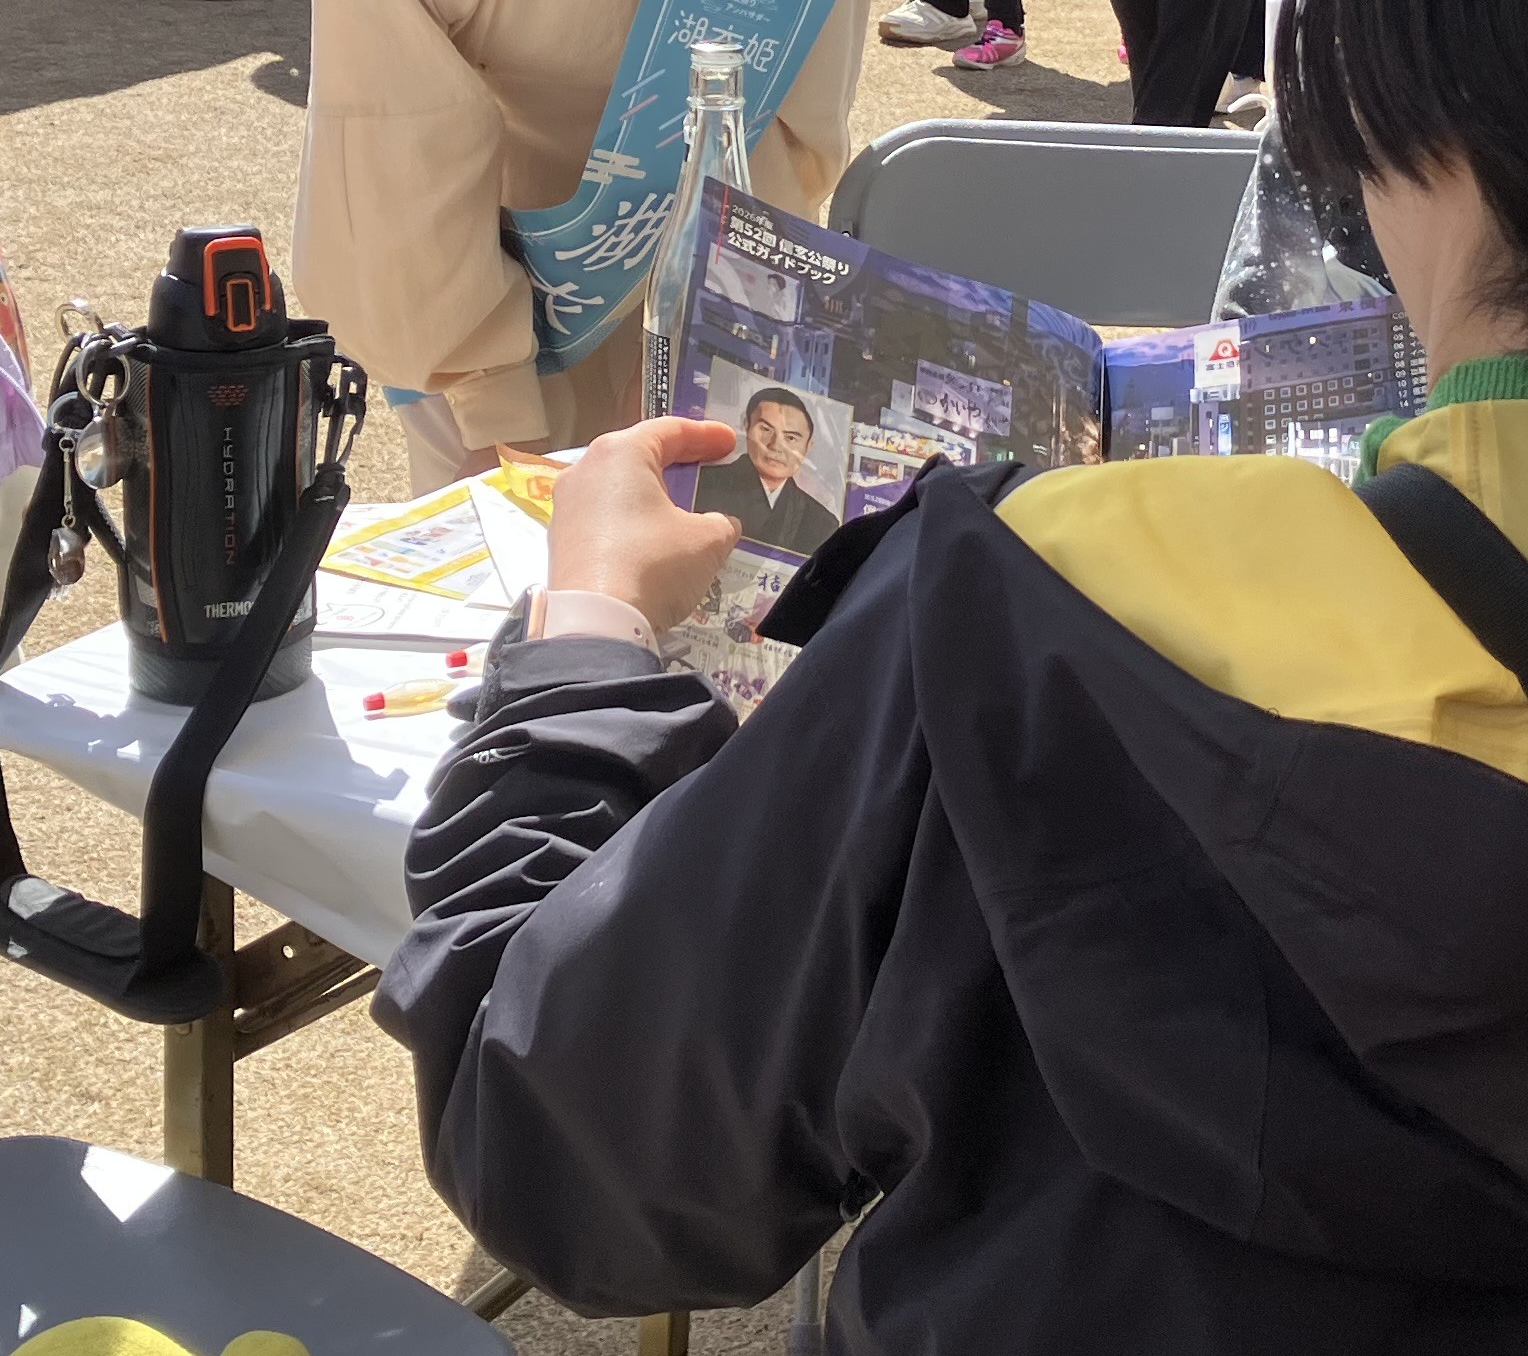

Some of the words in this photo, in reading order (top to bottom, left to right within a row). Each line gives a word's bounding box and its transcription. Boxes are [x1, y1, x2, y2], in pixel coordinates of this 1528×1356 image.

[726, 231, 837, 286] 公式ガイドブック
[729, 215, 777, 247] 第52回
[779, 238, 851, 276] 信玄公祭り
[223, 426, 237, 566] HYDRATION
[204, 600, 256, 620] THERMO
